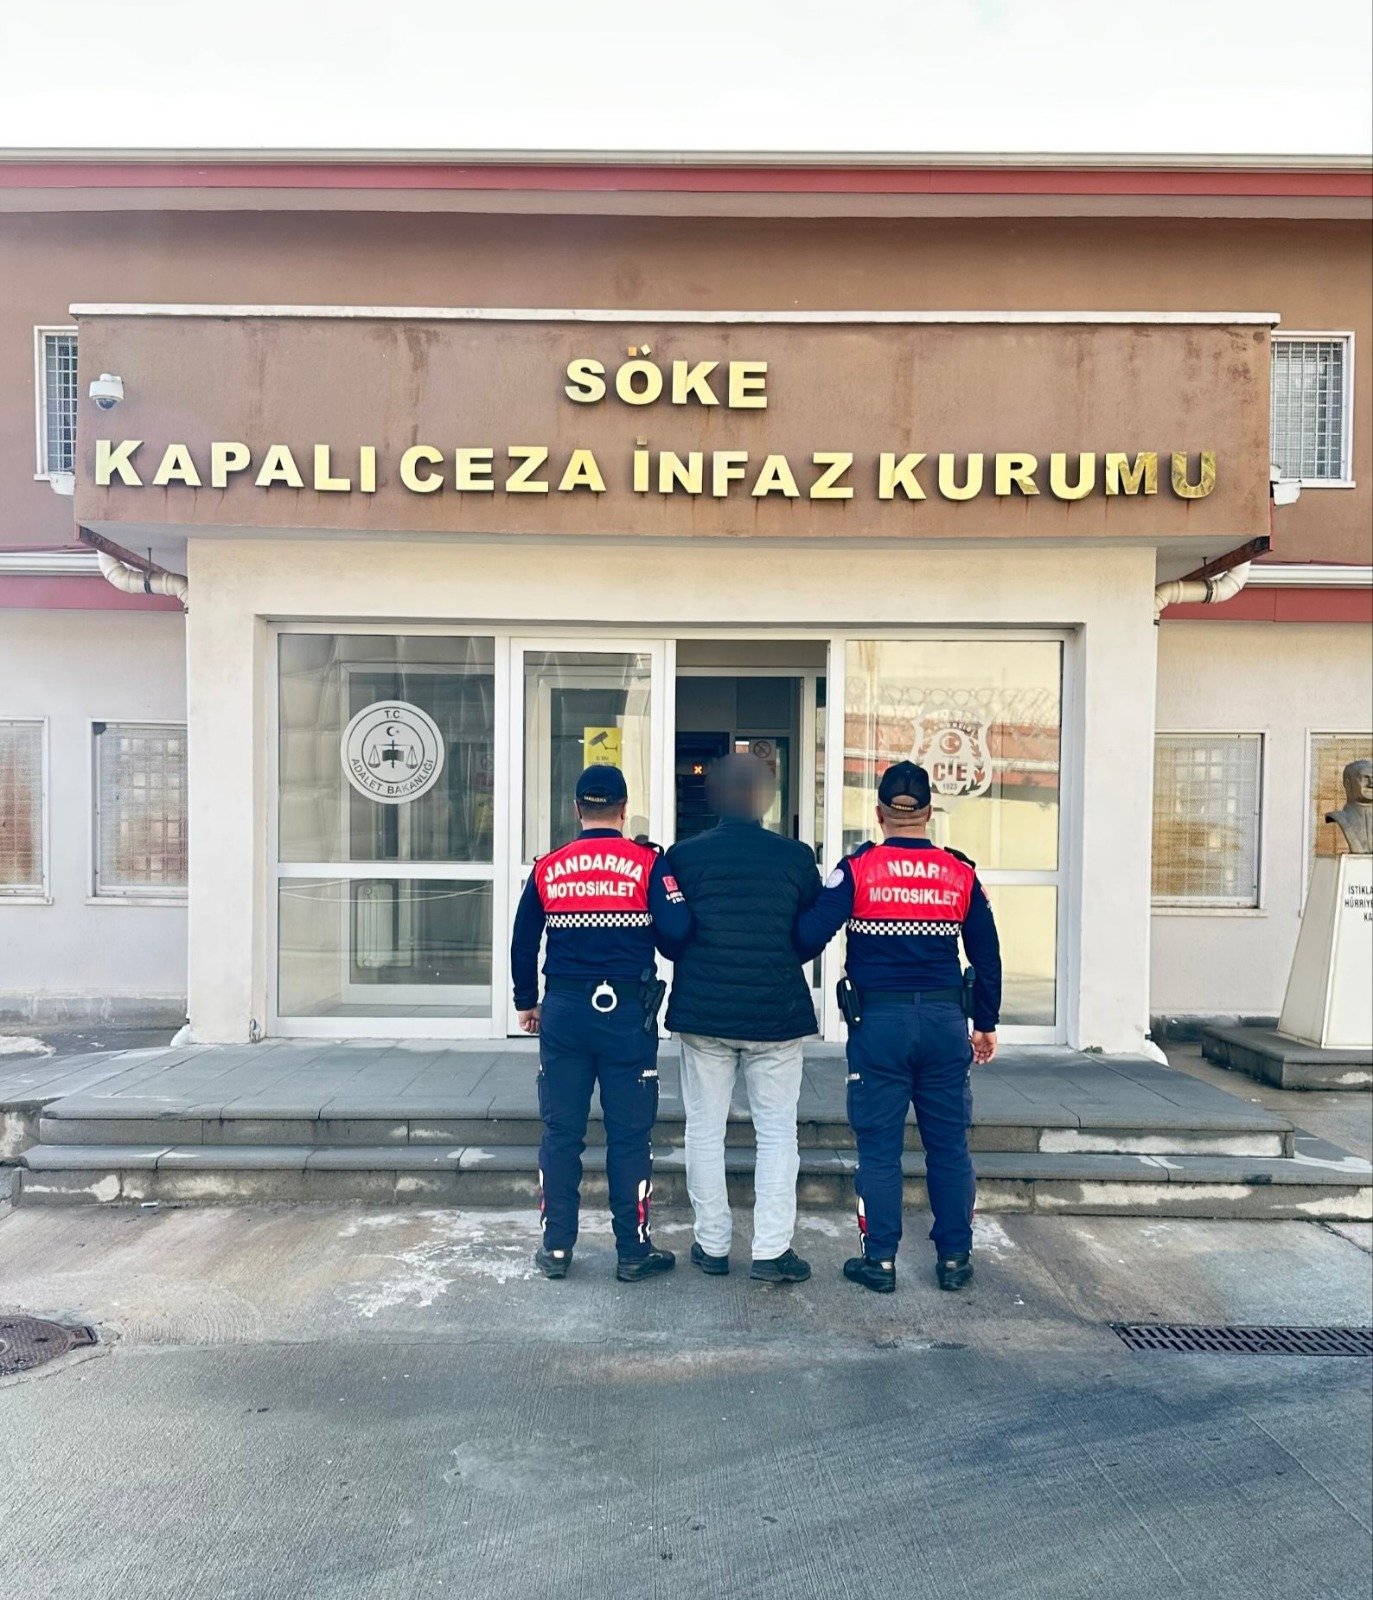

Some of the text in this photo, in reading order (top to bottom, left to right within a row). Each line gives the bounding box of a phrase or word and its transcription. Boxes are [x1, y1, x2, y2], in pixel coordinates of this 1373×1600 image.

[565, 344, 768, 410] SÖKE
[95, 436, 1217, 501] KAPALI CEZA İNFAZ KURUMU
[351, 758, 434, 795] ADALET BAKANLIĞI
[544, 853, 643, 883] JANDARMA
